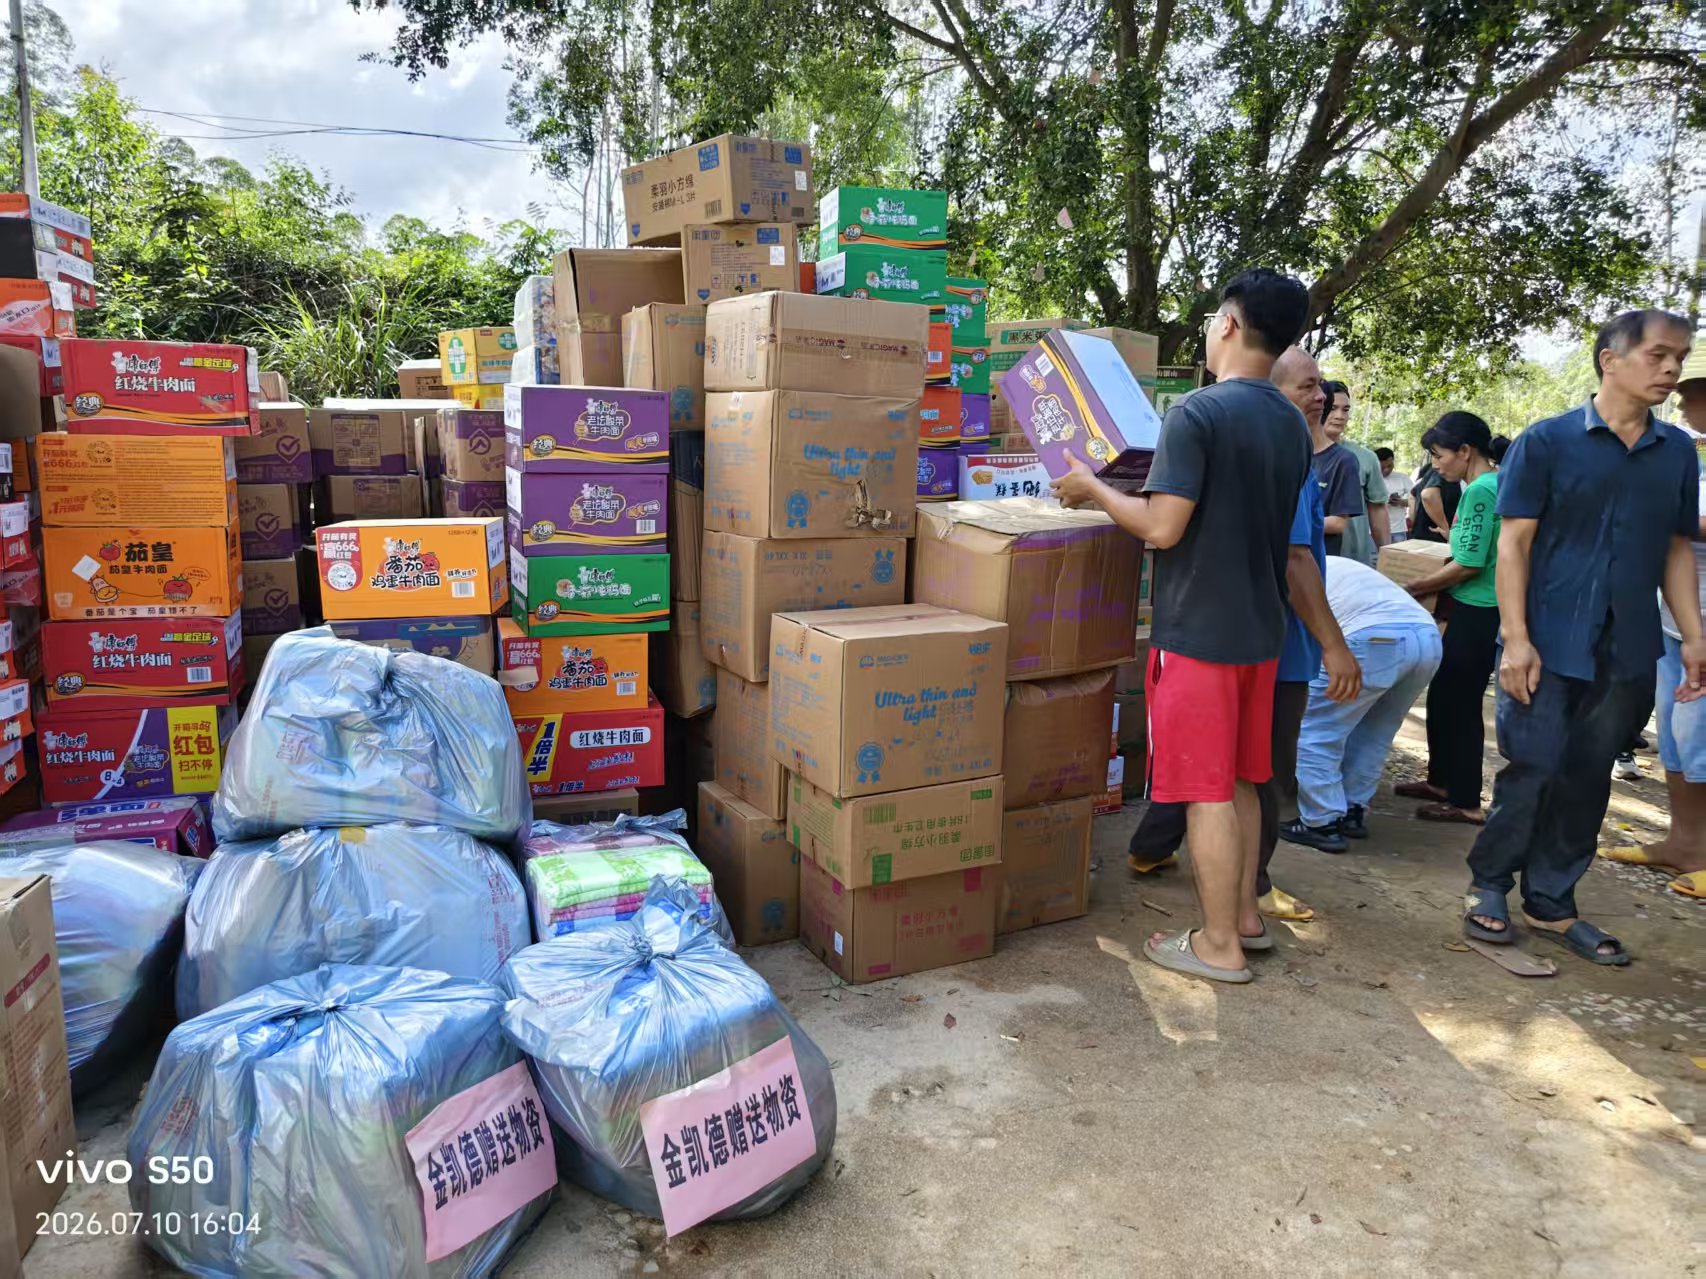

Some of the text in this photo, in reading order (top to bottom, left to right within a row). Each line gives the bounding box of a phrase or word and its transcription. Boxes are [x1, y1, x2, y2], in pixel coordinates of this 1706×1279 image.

[128, 355, 160, 373] 康师傅
[115, 376, 196, 392] 红烧牛肉面
[76, 396, 100, 408] 经典
[586, 416, 624, 426] 老坛酸菜
[590, 426, 620, 436] 牛肉面
[582, 500, 620, 510] 老坛酸菜
[585, 510, 615, 519] 牛肉面
[1466, 503, 1485, 553] OCEAN
[125, 542, 173, 562] 茄皇
[109, 565, 168, 575] 茄皇牛肉面
[386, 556, 423, 573] 番茄
[372, 573, 440, 589] 鸡蛋牛肉面
[85, 606, 198, 617] 番茄是个宝 茄皇错不了
[105, 635, 137, 650] 康师傅
[93, 653, 172, 669] 红烧牛肉面
[562, 660, 594, 676] 番茄
[57, 676, 82, 688] 经典
[549, 674, 608, 689] 鸡蛋牛肉面
[875, 681, 977, 708] Ultra thin and
[904, 704, 937, 726] light
[173, 735, 215, 755] 红包
[579, 729, 645, 746] 红烧牛肉面
[46, 750, 115, 764] 红烧牛肉面
[178, 759, 213, 772] 扫不停
[661, 1073, 802, 1189] 金凯德赠送物资
[427, 1097, 546, 1211] 金凯德赠送物资
